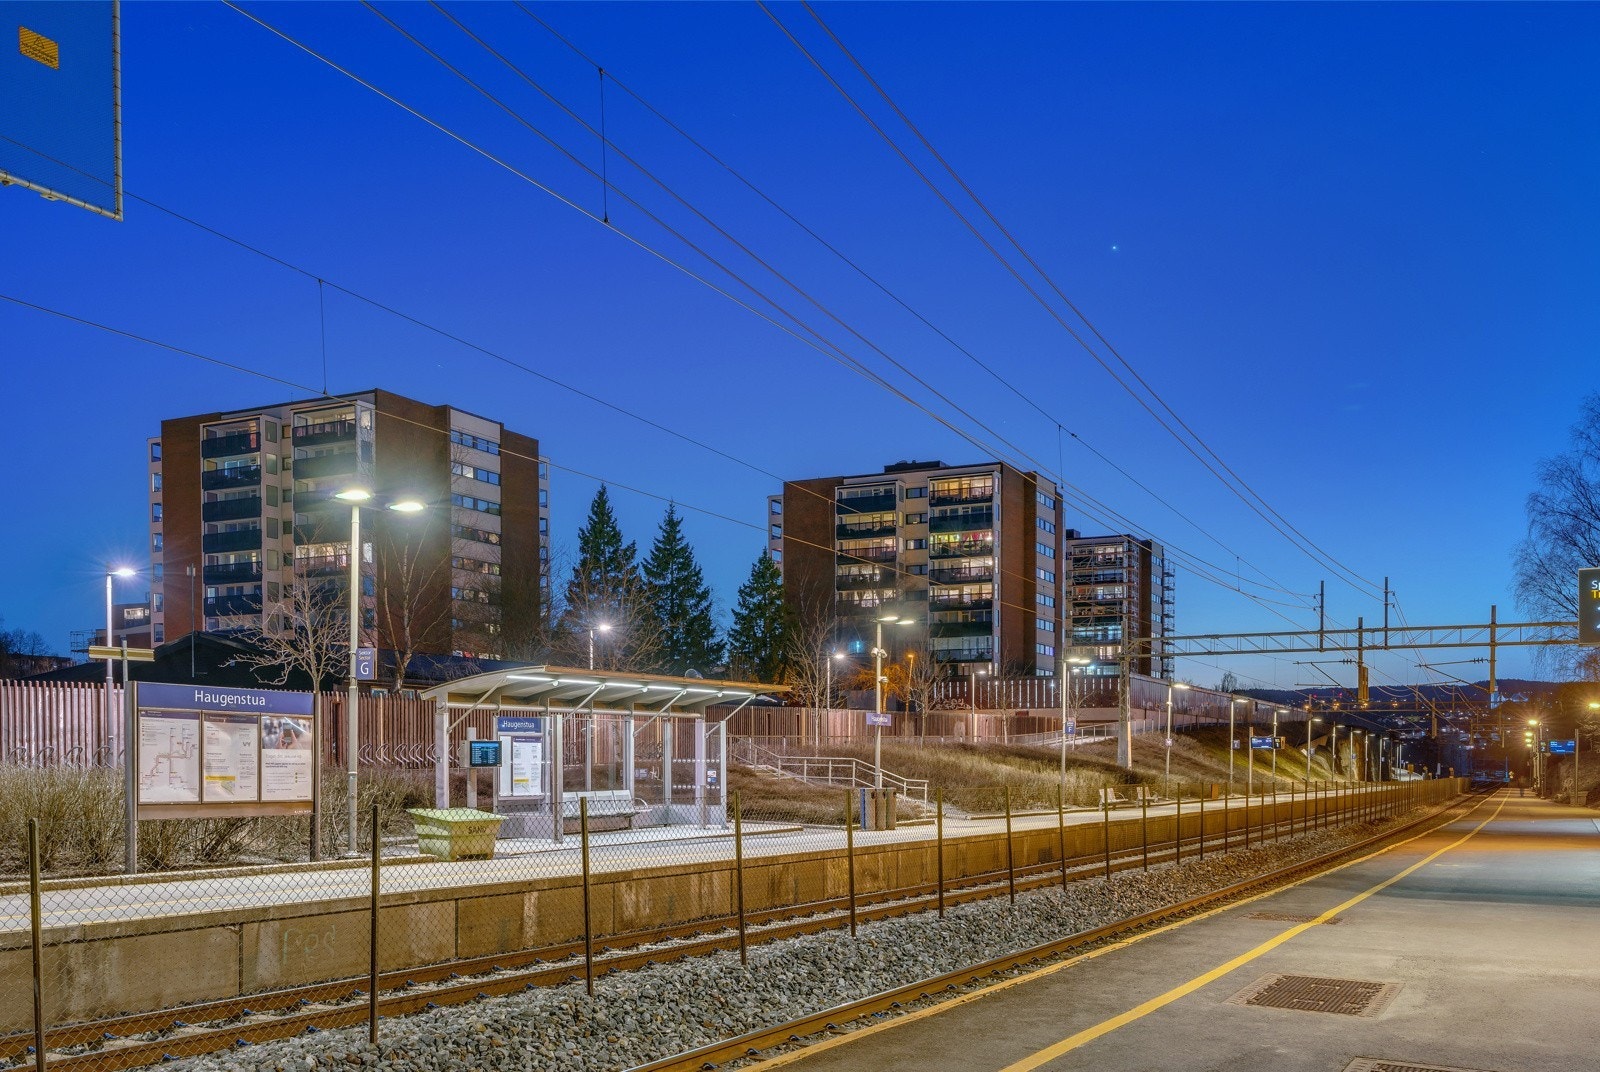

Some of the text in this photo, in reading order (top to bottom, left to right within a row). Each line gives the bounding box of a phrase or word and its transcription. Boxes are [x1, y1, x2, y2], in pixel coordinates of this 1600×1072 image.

[360, 662, 369, 675] G
[194, 689, 266, 707] Haugenstua
[503, 720, 535, 730] Haugenstua
